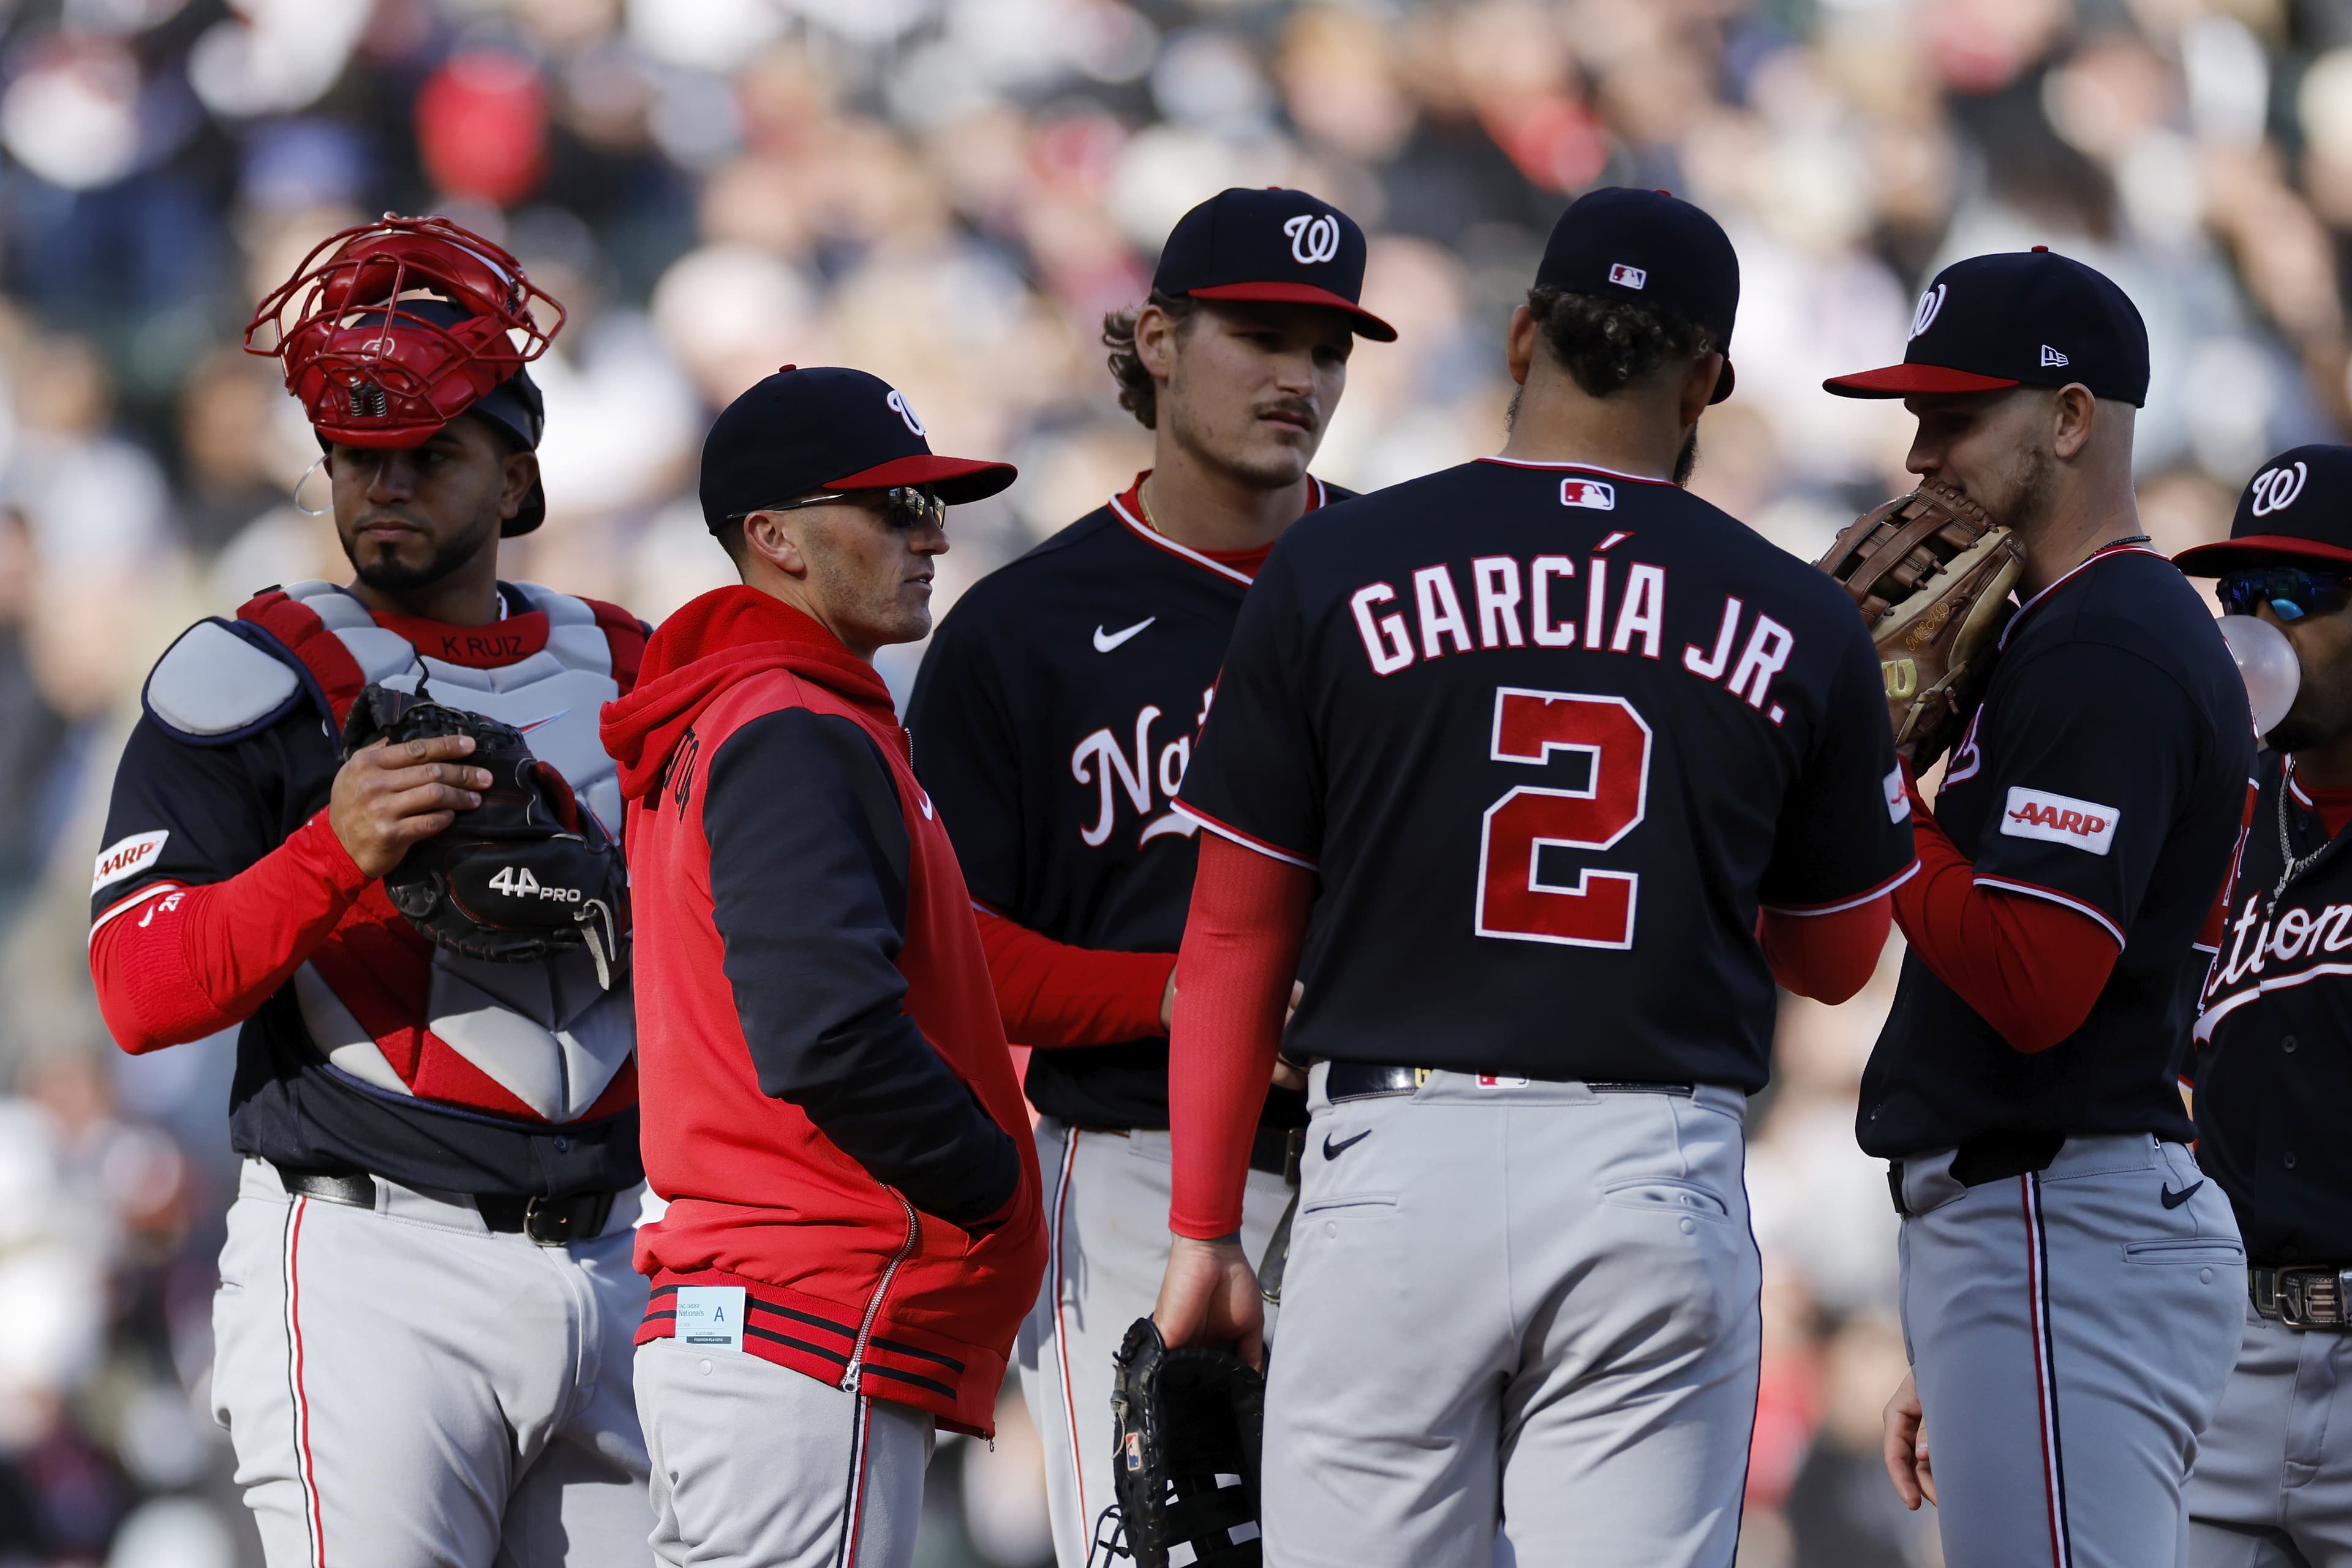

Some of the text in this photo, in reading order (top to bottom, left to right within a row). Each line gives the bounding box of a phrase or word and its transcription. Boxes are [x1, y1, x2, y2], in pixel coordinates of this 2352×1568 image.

[1283, 214, 1340, 265] W
[2252, 461, 2307, 517] W
[441, 636, 527, 657] K RUIZ
[1349, 530, 1795, 727] GARCÍA JR.
[1475, 686, 1653, 951] 2
[2008, 802, 2106, 837] AARP
[96, 841, 157, 880] AARP
[714, 1306, 725, 1322] A
